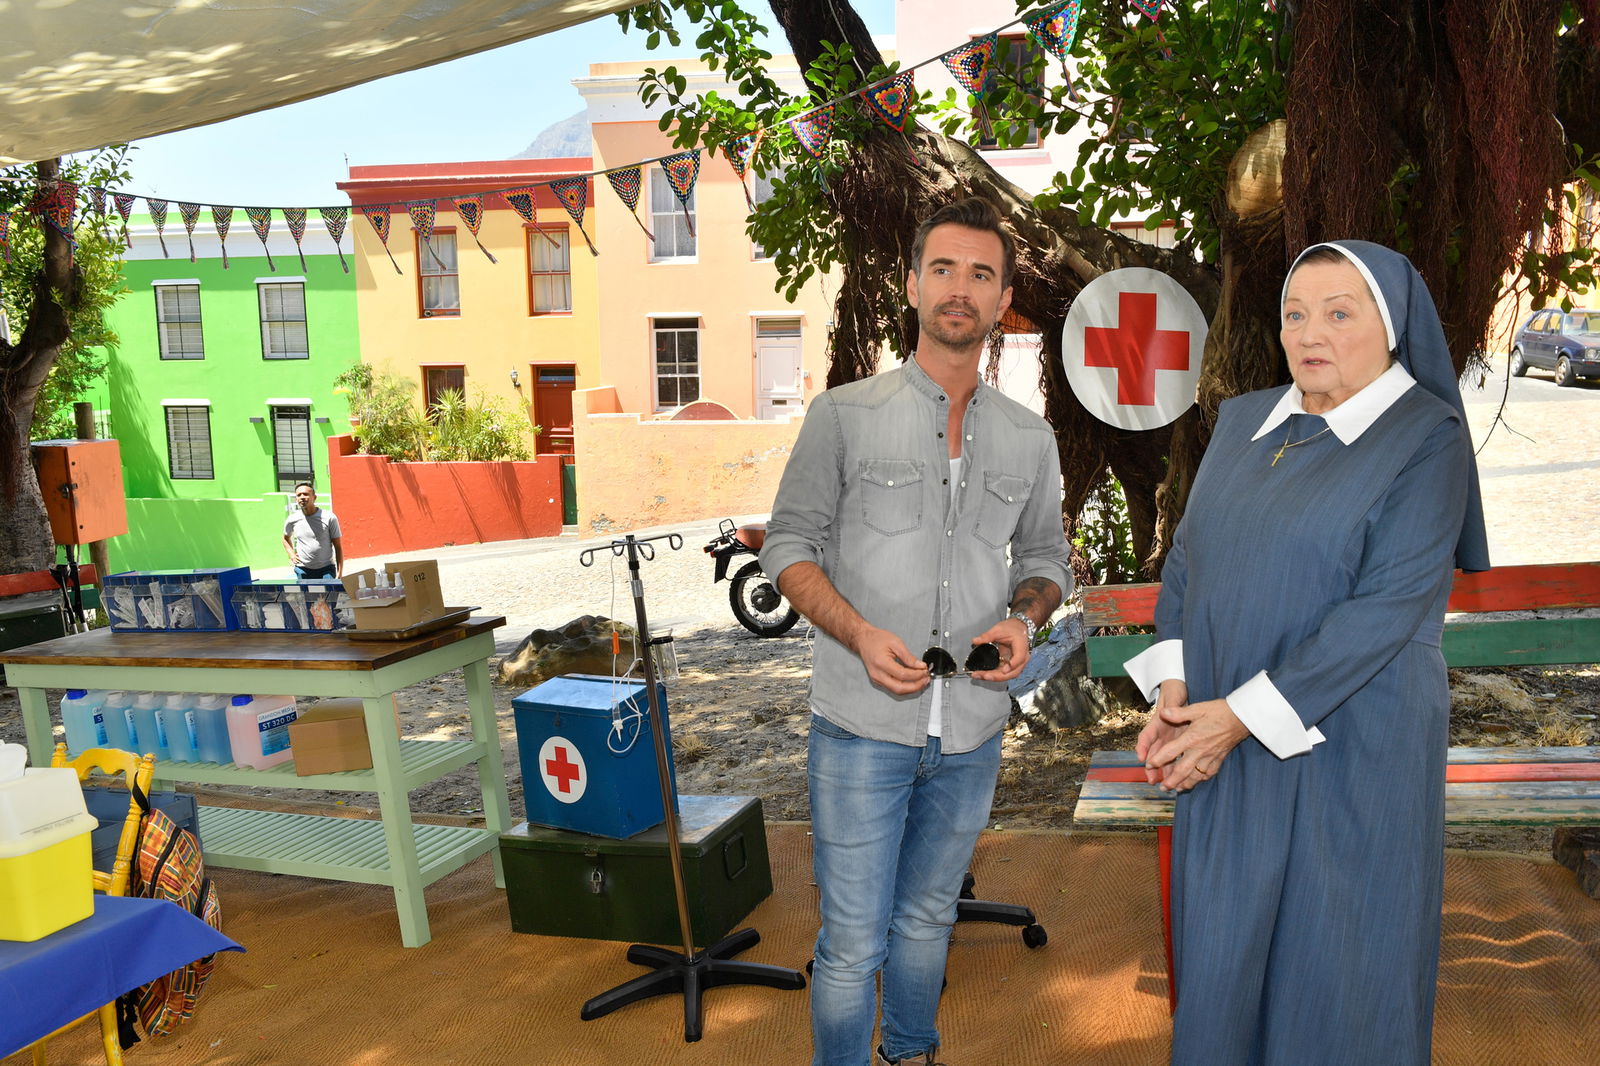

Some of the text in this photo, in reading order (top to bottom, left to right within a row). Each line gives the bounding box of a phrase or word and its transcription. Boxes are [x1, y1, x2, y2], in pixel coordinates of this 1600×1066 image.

[413, 572, 426, 582] 012
[262, 713, 296, 730] ST 320 DC
